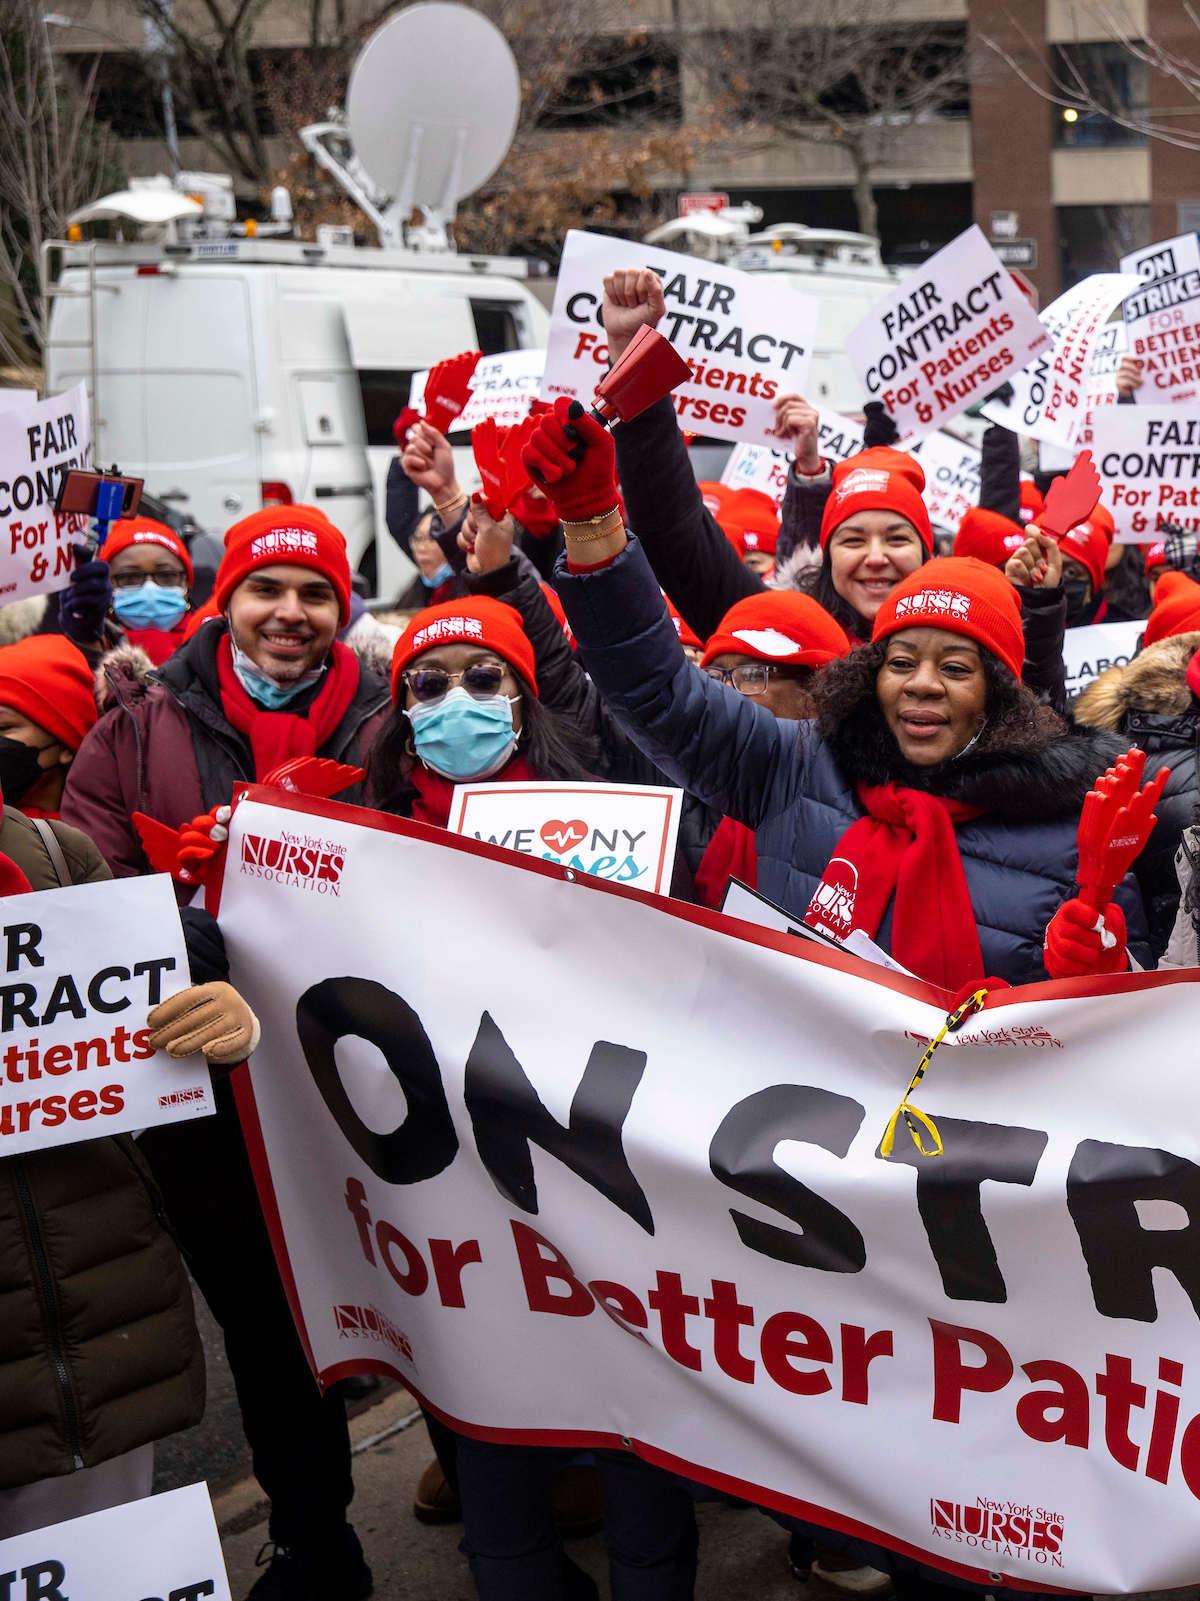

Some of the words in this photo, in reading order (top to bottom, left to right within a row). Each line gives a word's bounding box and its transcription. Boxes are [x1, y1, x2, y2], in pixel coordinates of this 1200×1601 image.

[1138, 250, 1174, 278] ON
[881, 281, 942, 341] FAIR
[1149, 309, 1184, 331] FOR
[566, 292, 804, 370] CTRACT
[865, 272, 1006, 394] CONTRACT
[573, 332, 610, 364] Fo
[685, 357, 778, 400] tients
[882, 379, 919, 414] For
[920, 312, 1014, 387] Patients
[472, 376, 543, 392] TRACT
[915, 402, 934, 424] &
[934, 347, 1014, 413] Nurses
[1086, 393, 1115, 406] TER
[672, 393, 747, 427] rses
[1045, 379, 1063, 422] For
[27, 413, 78, 462] FAIR
[768, 464, 788, 488] Fo
[1112, 485, 1152, 506] For
[1131, 512, 1148, 532] &
[10, 521, 48, 555] For
[251, 532, 318, 554] NURSES
[30, 552, 49, 583] &
[895, 594, 971, 614] NURSES
[938, 588, 954, 597] York
[895, 606, 969, 622] ASSOCIATION
[413, 620, 482, 646] NURSES
[1064, 655, 1131, 680] LABO
[280, 830, 302, 844] New
[302, 834, 323, 850] York
[323, 840, 347, 856] State
[475, 829, 536, 853] WE
[590, 828, 646, 852] NY
[241, 833, 346, 885] NURSES
[542, 852, 650, 882] ses
[240, 863, 341, 898] ASSOCIATION
[833, 882, 852, 898] New
[808, 898, 851, 934] SOCIAT
[813, 881, 855, 922] URS
[0, 957, 176, 1033] RACT
[953, 1034, 980, 1045] New
[980, 1027, 1011, 1040] York
[1011, 1025, 1045, 1037] State
[0, 1026, 157, 1086] tients
[158, 1089, 204, 1106] NURSES
[296, 976, 655, 1236] ON
[344, 1176, 482, 1310] for
[509, 1219, 894, 1406] Better
[976, 1496, 1006, 1513] New
[1007, 1501, 1034, 1518] York
[1036, 1507, 1065, 1525] State
[930, 1497, 1065, 1556] NURSES
[931, 1526, 1064, 1568] ASSOCIATION
